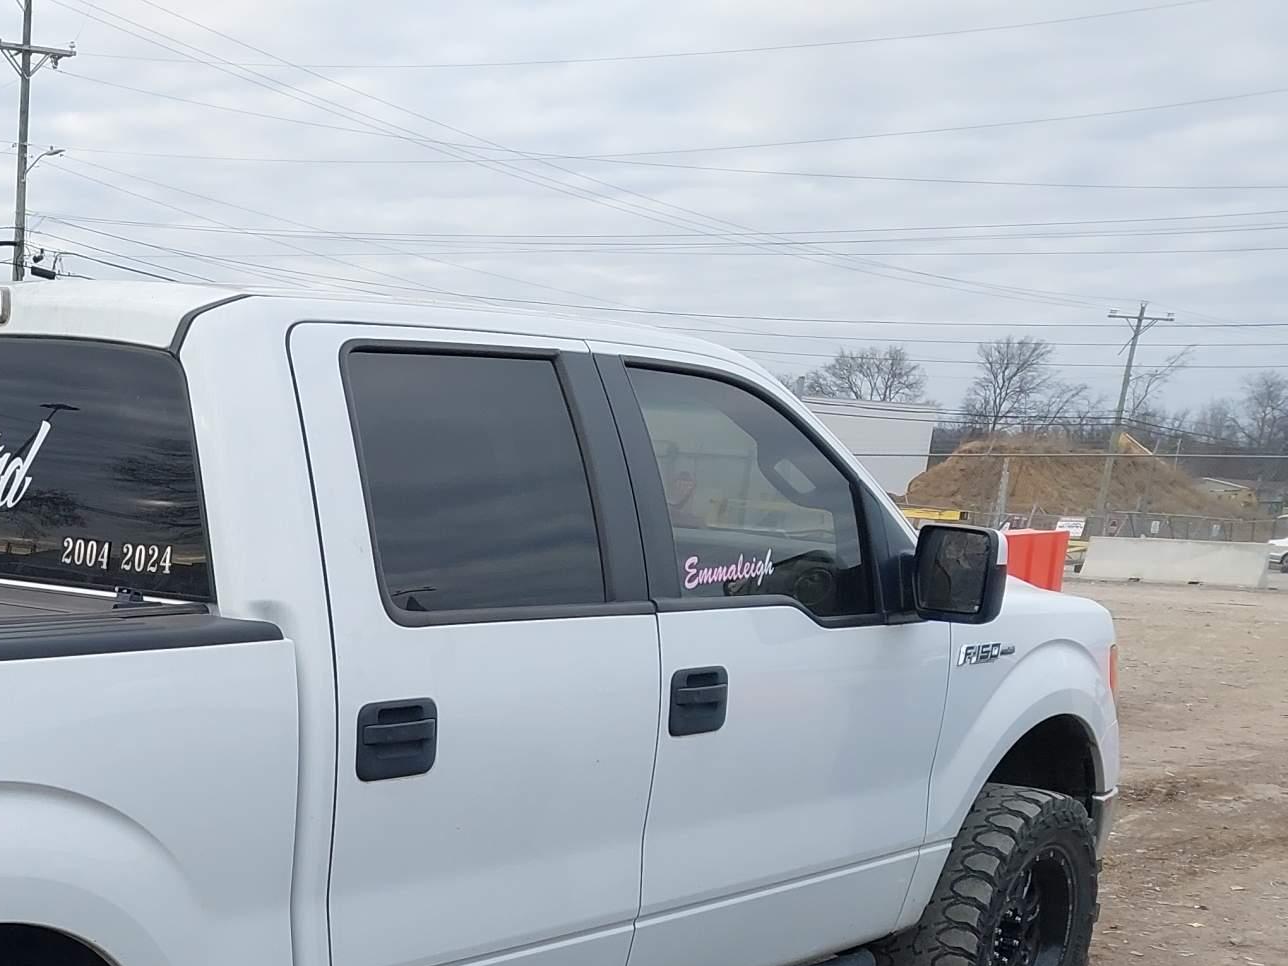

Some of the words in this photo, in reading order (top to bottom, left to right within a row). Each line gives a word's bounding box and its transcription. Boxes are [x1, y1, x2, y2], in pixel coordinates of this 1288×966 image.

[61, 537, 110, 569] 2004
[120, 543, 172, 574] 2024
[684, 548, 775, 589] Emmaleigh
